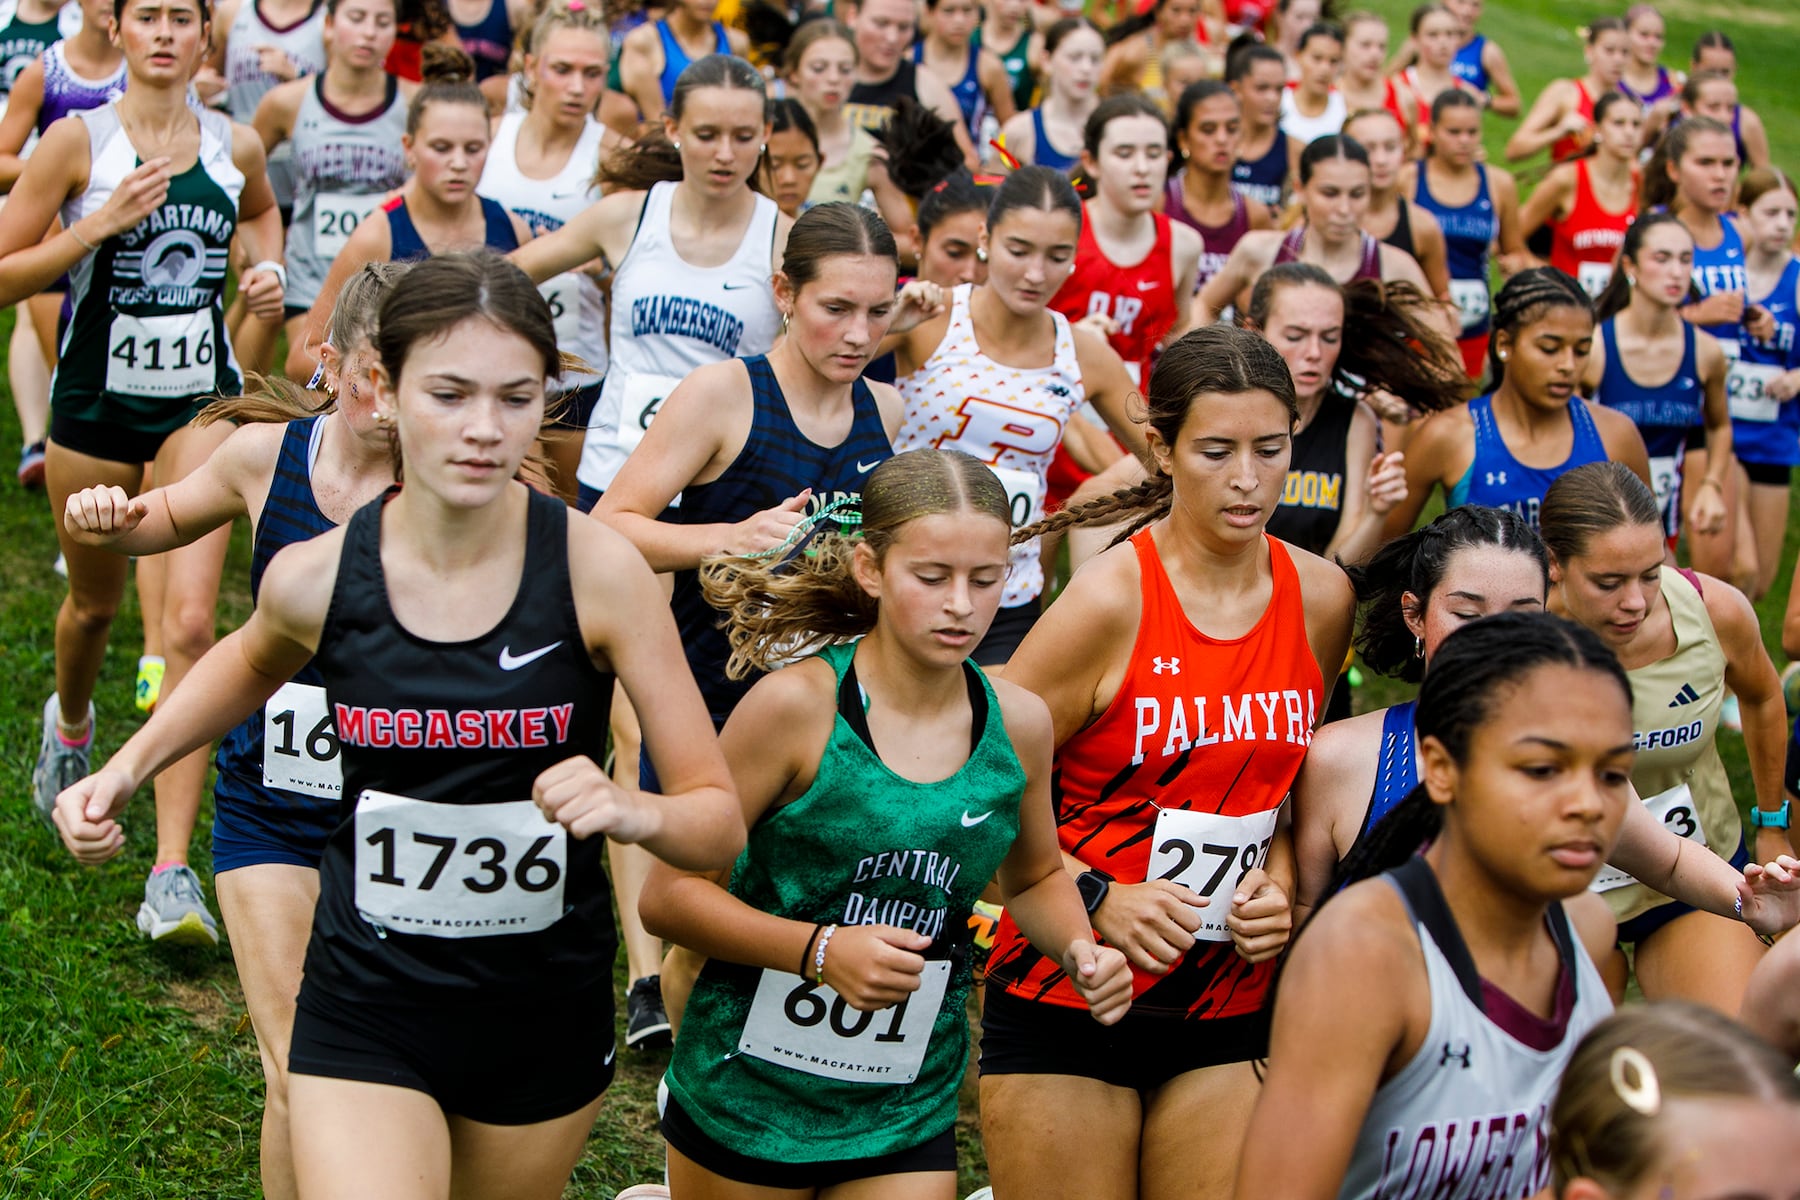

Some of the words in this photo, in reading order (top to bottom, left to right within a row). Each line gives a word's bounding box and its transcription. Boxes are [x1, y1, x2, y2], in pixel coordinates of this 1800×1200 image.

[120, 203, 233, 247] SPARTANS
[320, 210, 372, 237] 20
[632, 295, 743, 357] CHAMBERSBURG
[112, 329, 212, 370] 4116
[1281, 470, 1341, 510] DOM
[272, 709, 341, 762] 16
[334, 703, 574, 749] MCCASKEY
[1665, 806, 1697, 838] 3
[366, 827, 560, 893] 1736
[853, 850, 960, 895] CENTRAL
[784, 981, 906, 1043] 601
